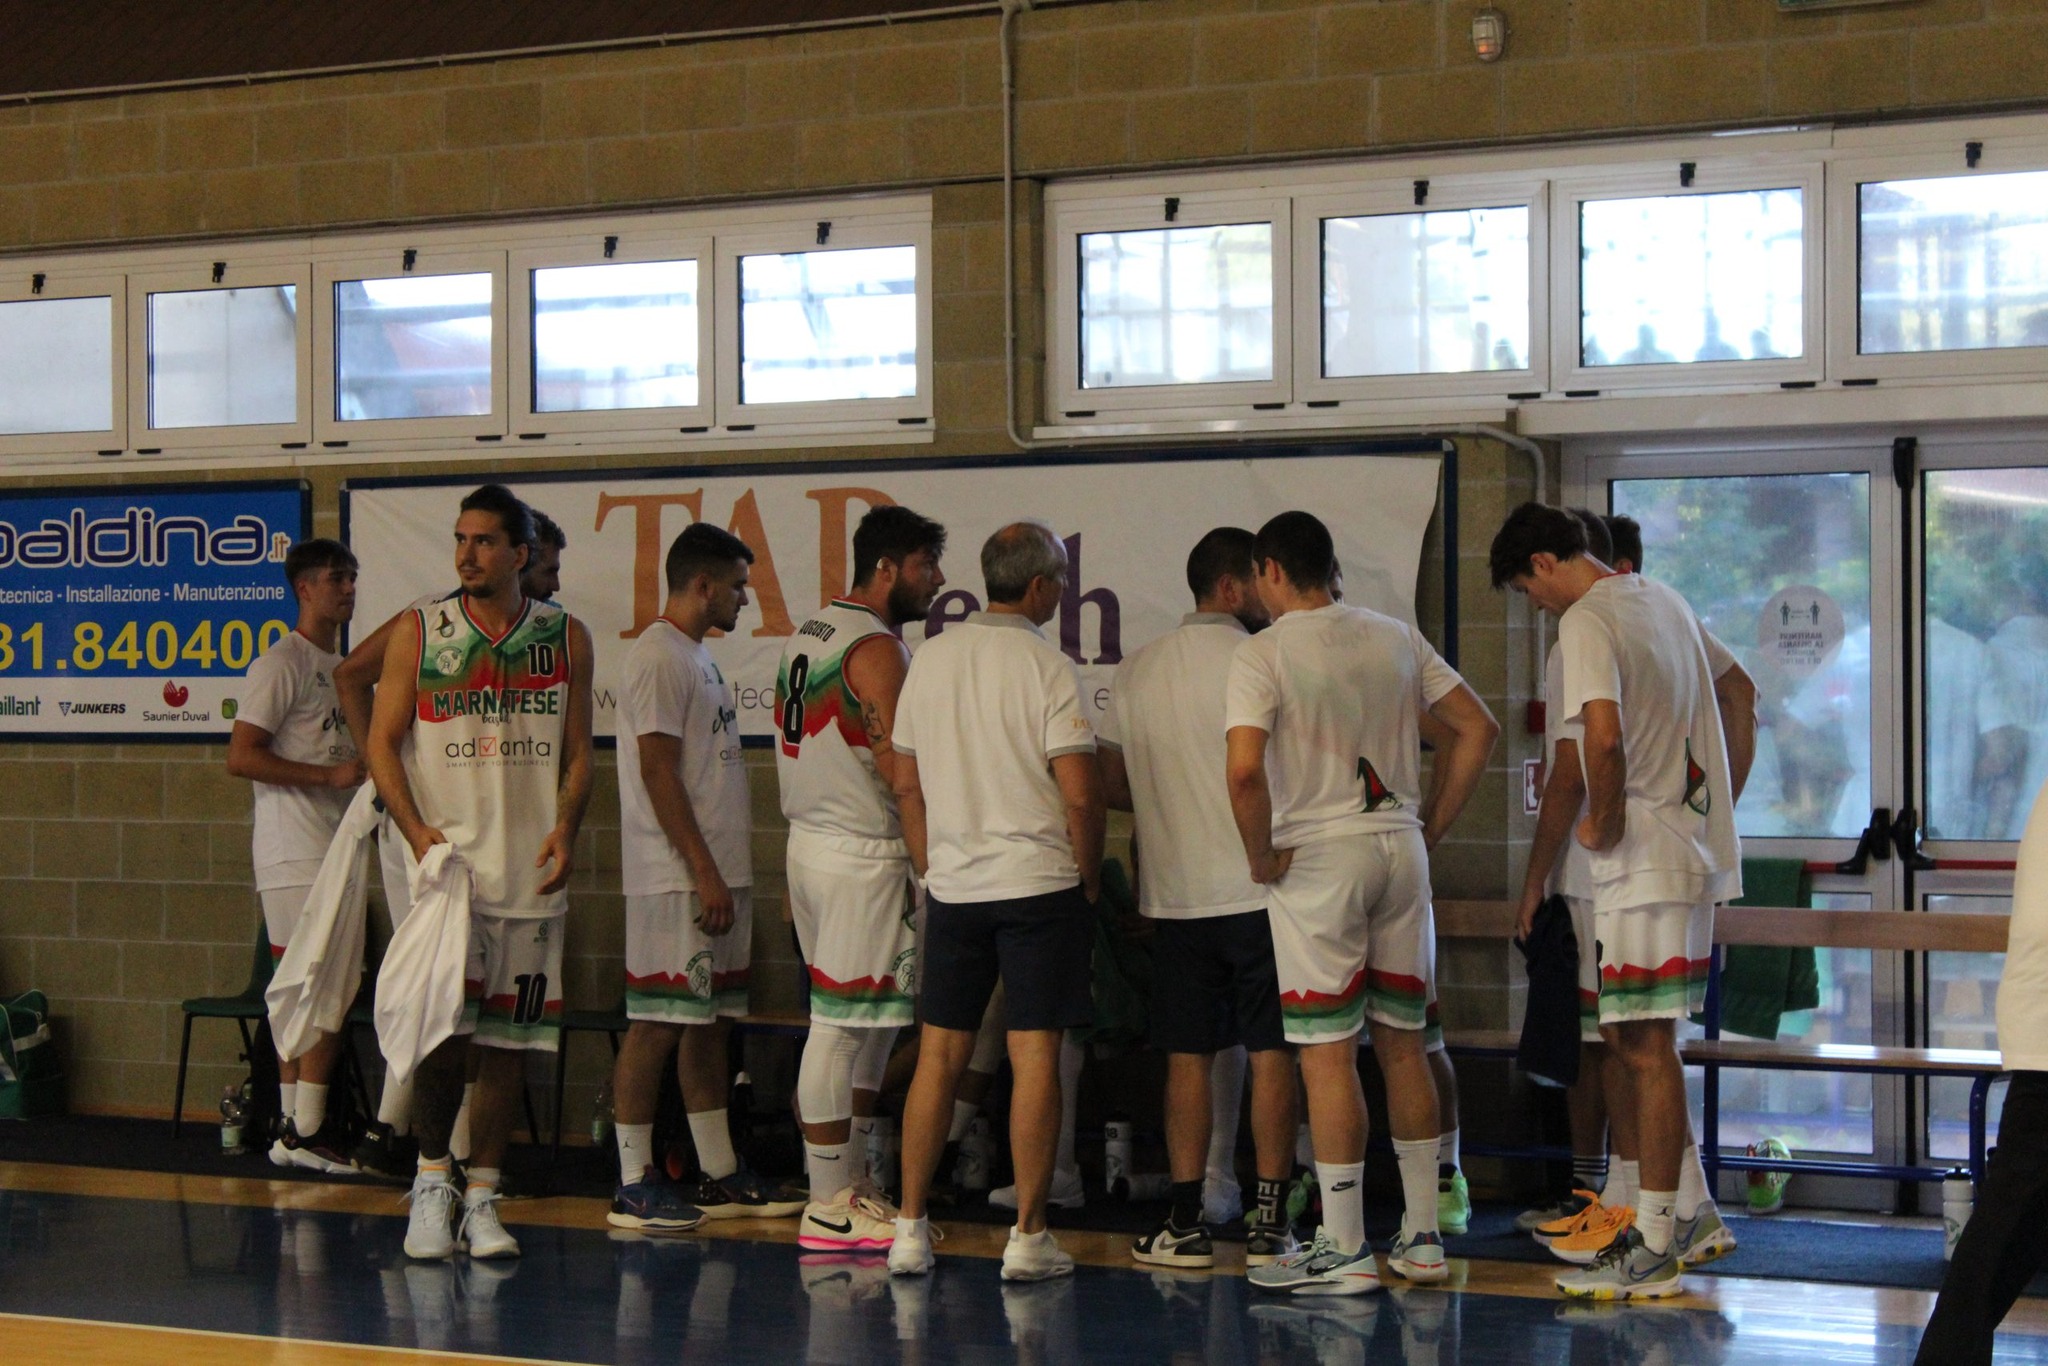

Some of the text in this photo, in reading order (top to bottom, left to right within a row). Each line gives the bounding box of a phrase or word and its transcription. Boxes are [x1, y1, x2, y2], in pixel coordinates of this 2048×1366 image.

[66, 584, 160, 603] Installazione
[173, 581, 285, 602] Manutenzione
[799, 619, 836, 642] AUGUSTO
[527, 642, 555, 678] 10
[71, 703, 126, 714] JUNKERS
[433, 688, 559, 718] MARNATESE
[782, 653, 809, 745] 8
[143, 711, 210, 722] Saunier Duval
[513, 972, 548, 1025] 10
